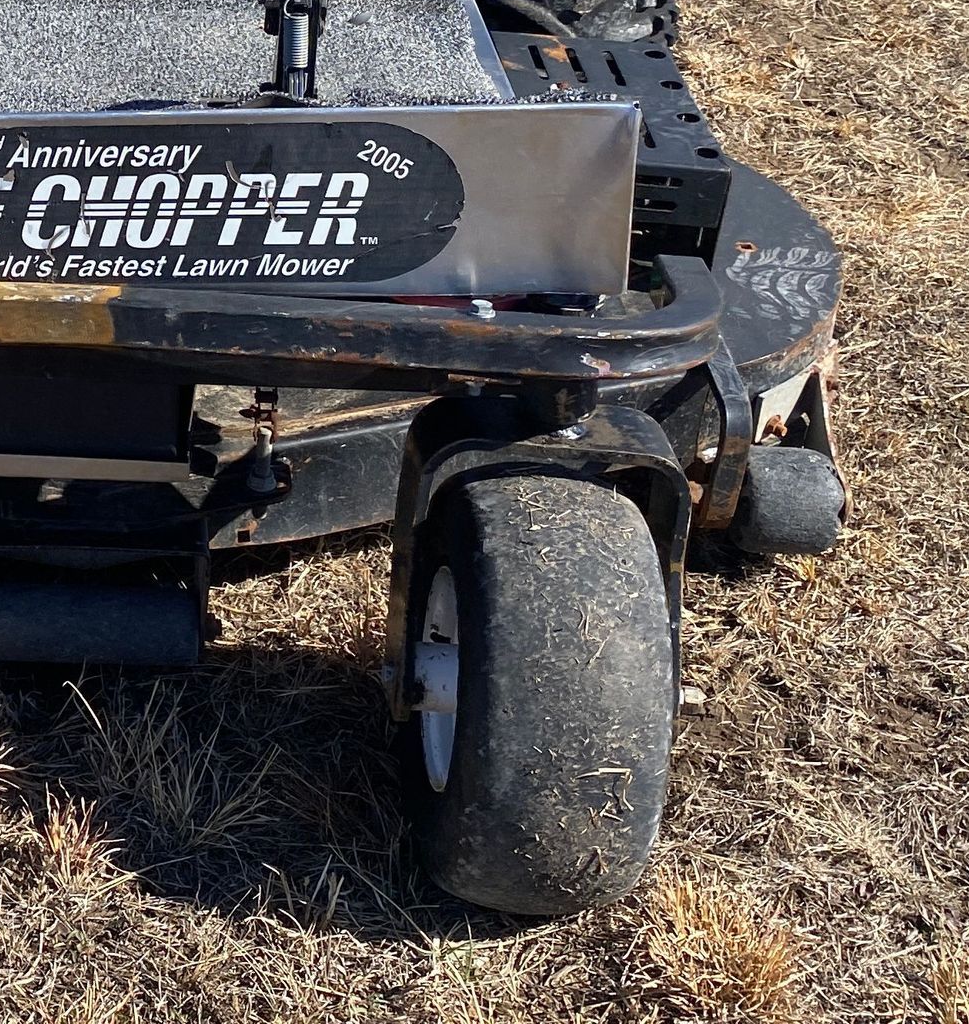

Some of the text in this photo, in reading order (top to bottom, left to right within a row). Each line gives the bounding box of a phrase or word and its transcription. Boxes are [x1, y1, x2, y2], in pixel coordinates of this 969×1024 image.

[7, 138, 202, 174] Anniversary
[357, 139, 416, 180] 2005
[20, 172, 370, 249] CHOPPER
[61, 255, 168, 278] Fastest
[175, 254, 249, 277] Lawn
[255, 253, 354, 277] Mower
